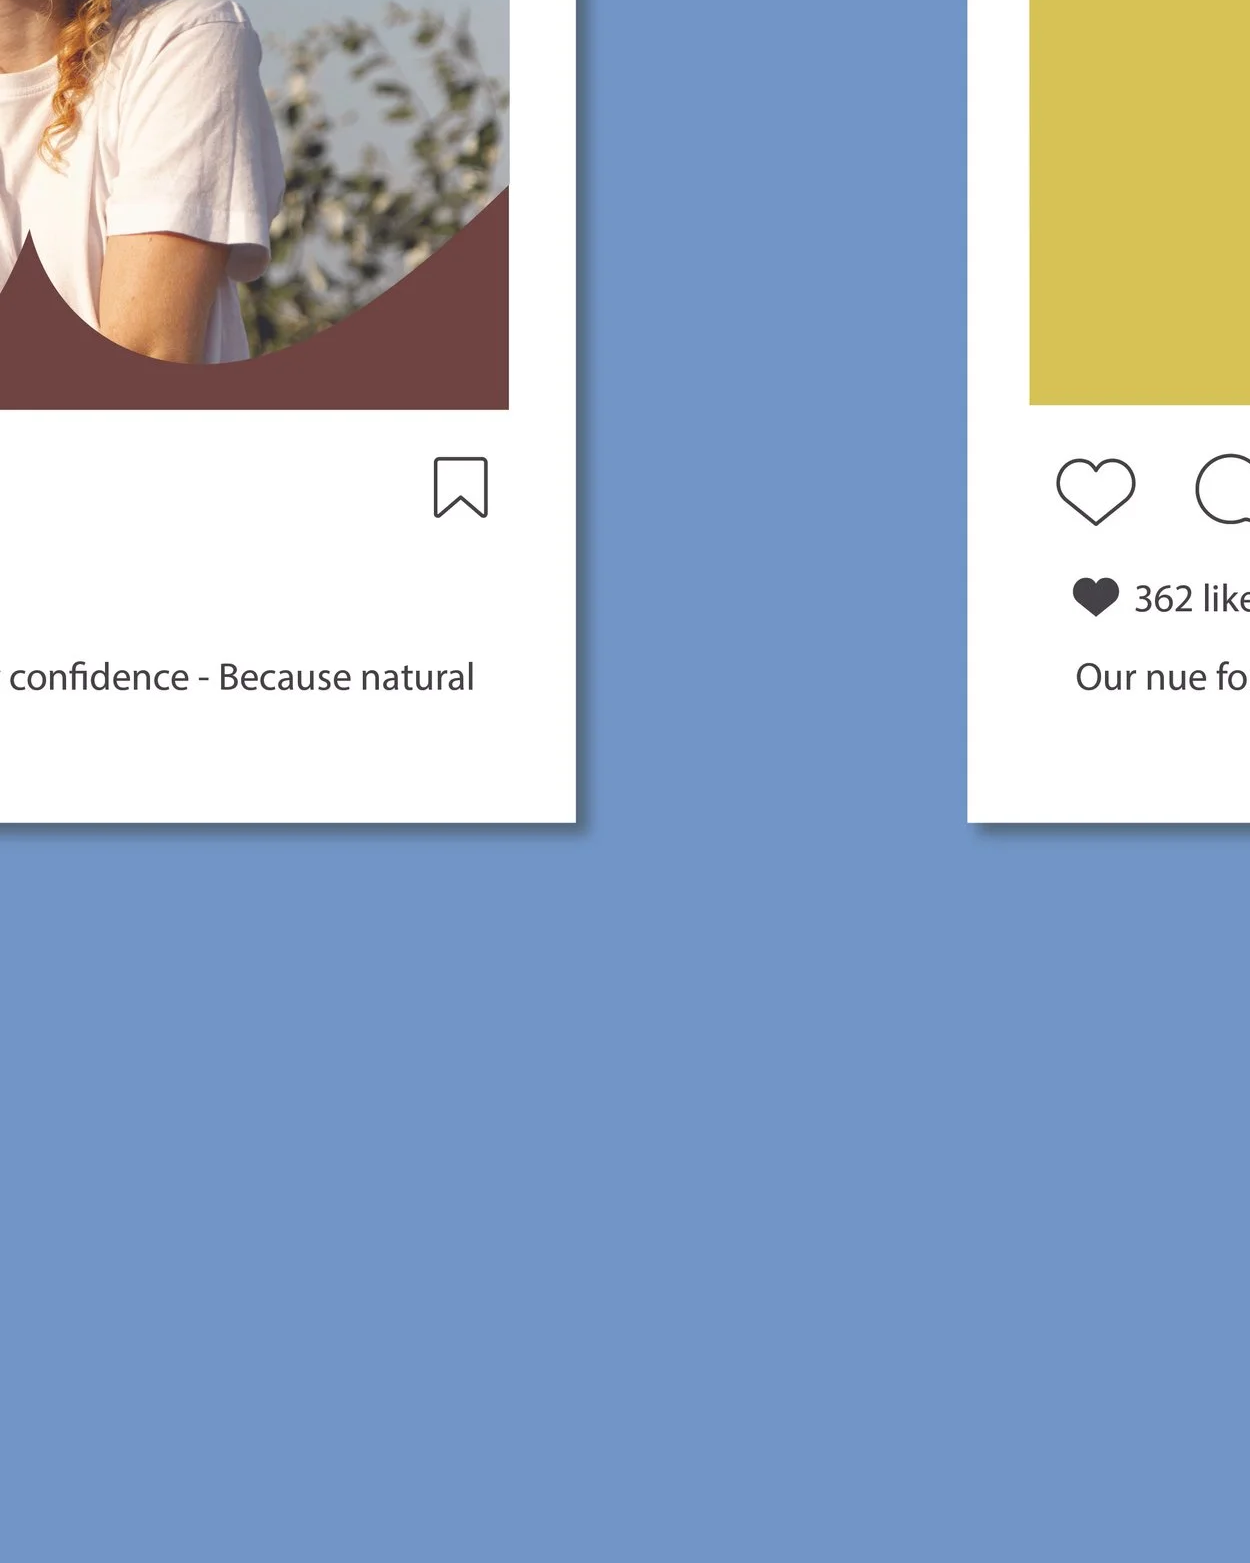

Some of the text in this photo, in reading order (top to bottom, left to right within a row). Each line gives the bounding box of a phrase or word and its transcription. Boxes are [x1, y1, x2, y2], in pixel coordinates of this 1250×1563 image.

[1134, 584, 1193, 613] 362
[9, 660, 190, 691] confidence
[220, 662, 352, 691] Because
[361, 661, 474, 691] natural
[1076, 662, 1137, 691] Our
[1146, 669, 1207, 691] nue
